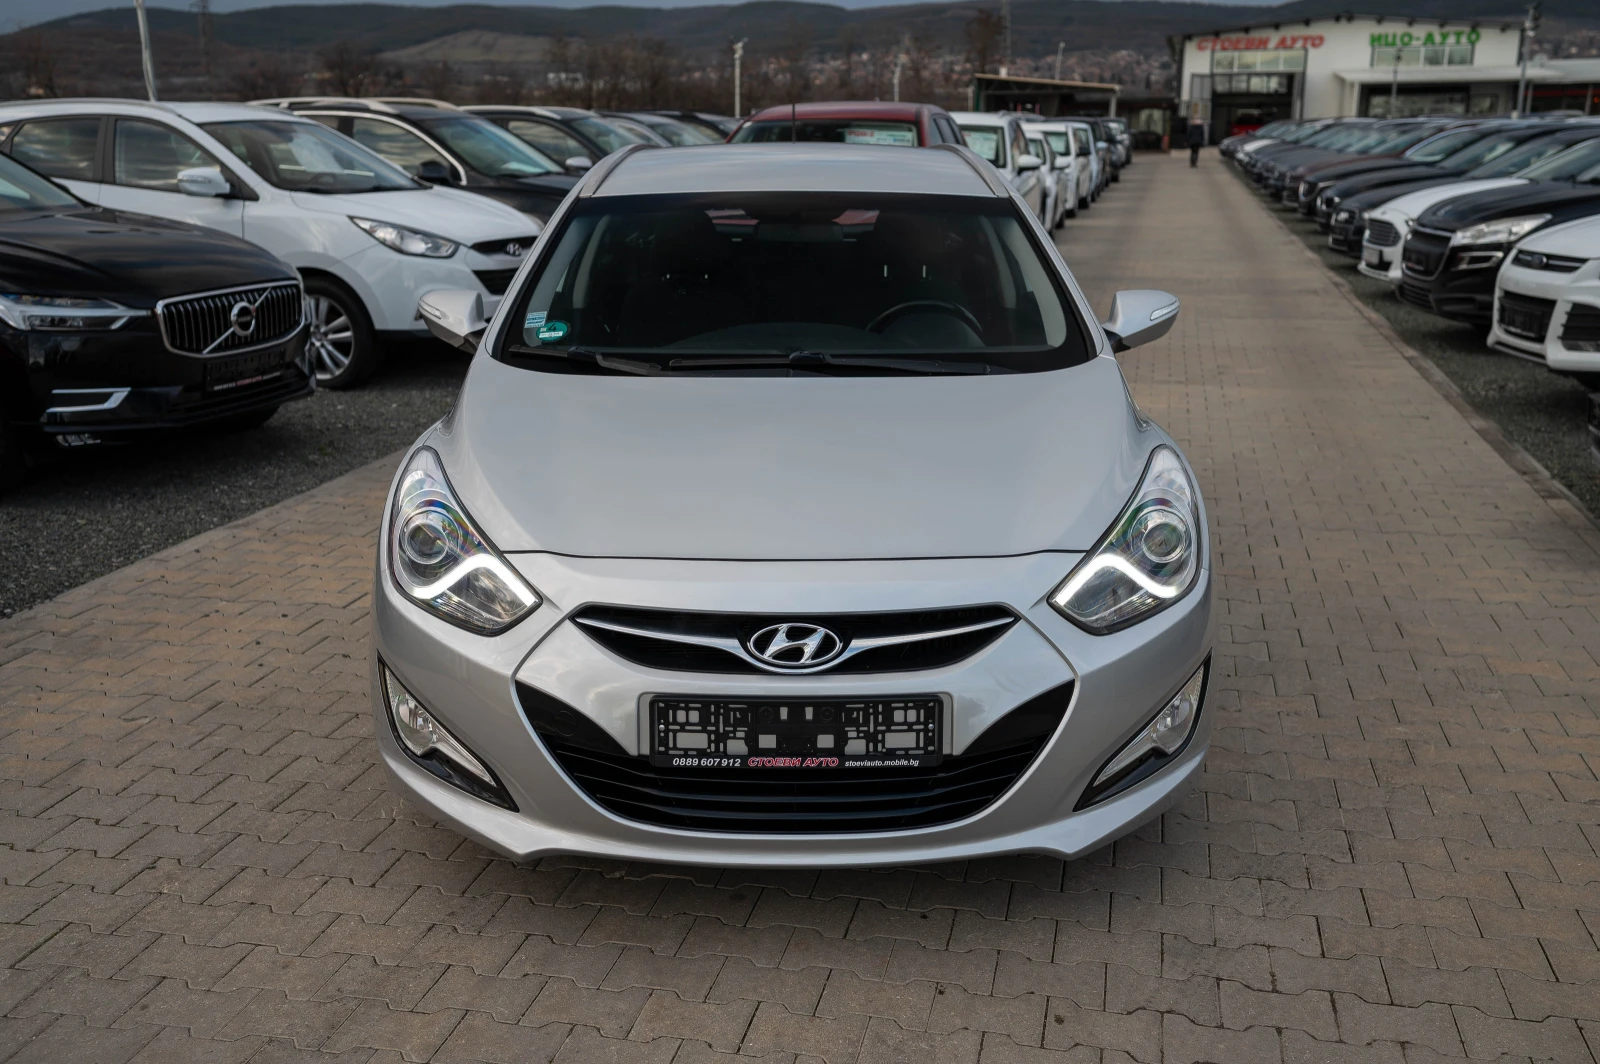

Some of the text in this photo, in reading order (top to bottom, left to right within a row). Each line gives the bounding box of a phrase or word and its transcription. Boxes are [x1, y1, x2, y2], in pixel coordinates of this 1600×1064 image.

[1196, 34, 1325, 52] СТОЕВИ АУТО
[1370, 30, 1481, 47] ИЦО-АУТО
[673, 757, 919, 768] 0889 607 912 СТОЕВИ АУТО stoeviauto.mobile.bg
